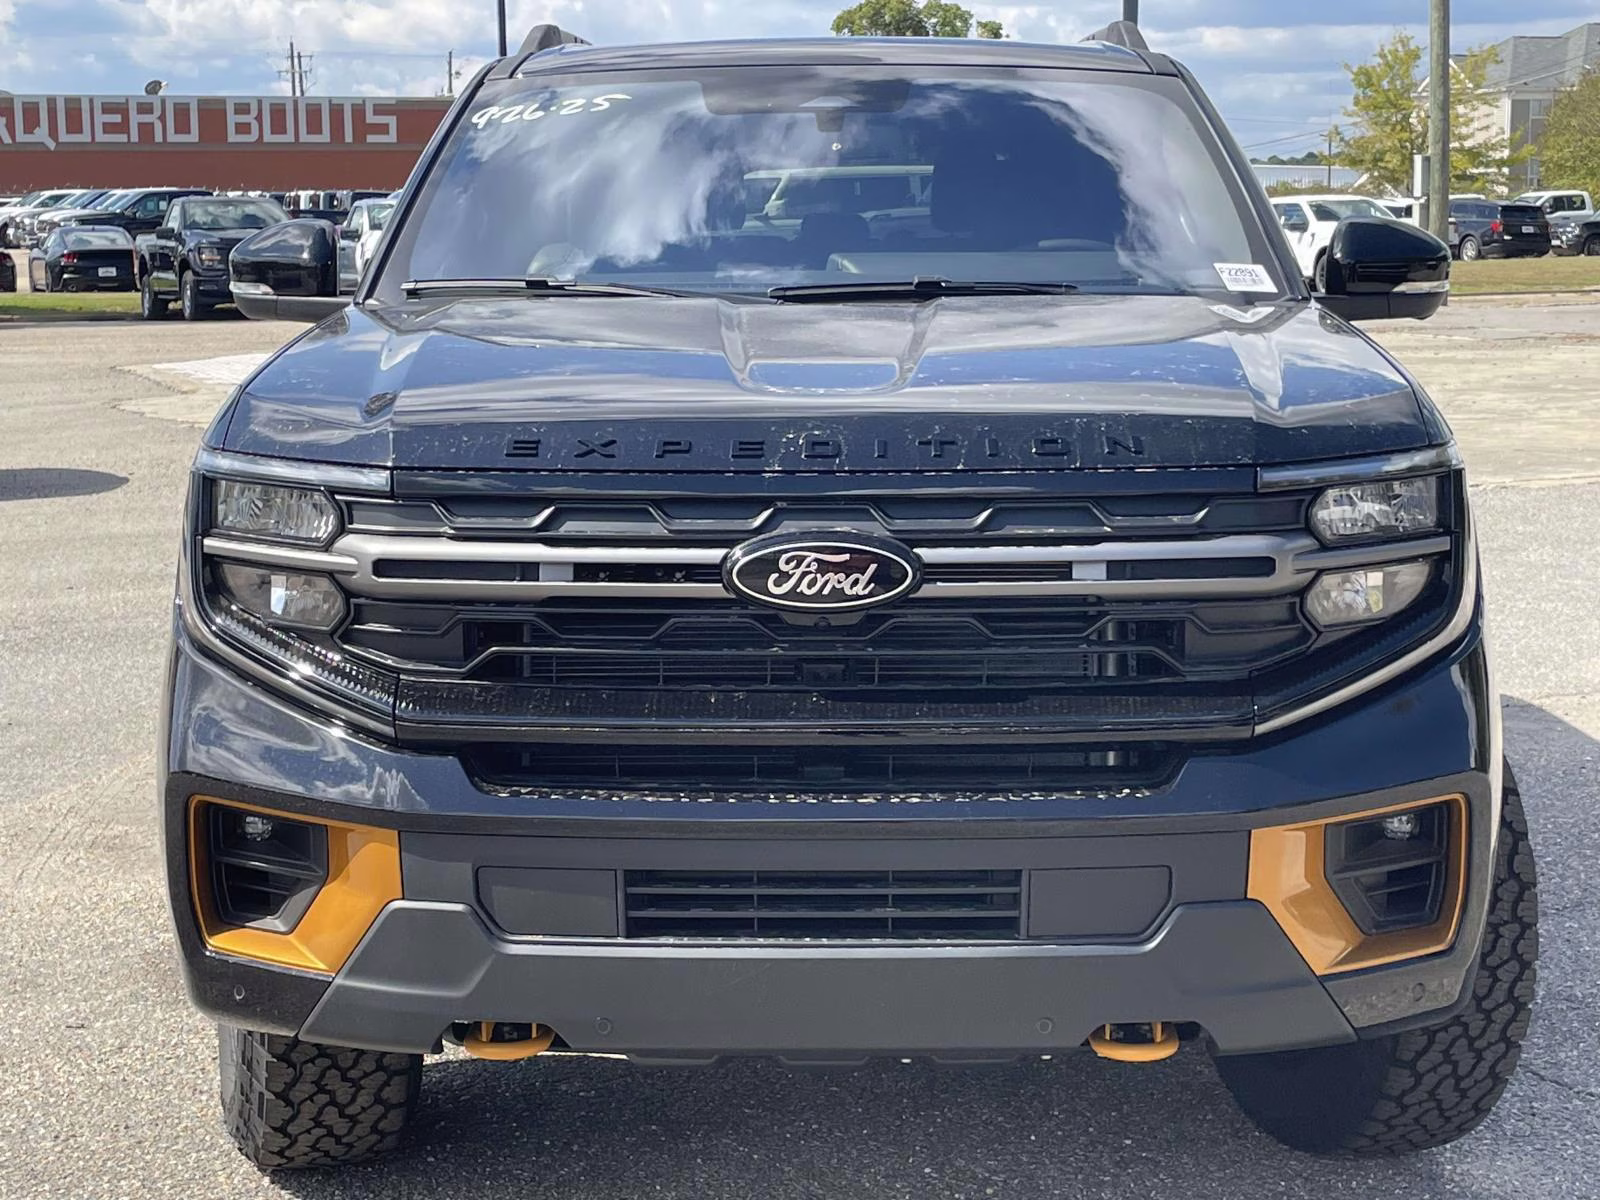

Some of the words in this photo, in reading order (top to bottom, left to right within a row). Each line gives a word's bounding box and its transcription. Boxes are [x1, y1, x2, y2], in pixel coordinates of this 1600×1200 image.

[226, 97, 397, 142] BOOTS
[505, 435, 1144, 459] EXPEDITION
[767, 551, 878, 596] Ford
